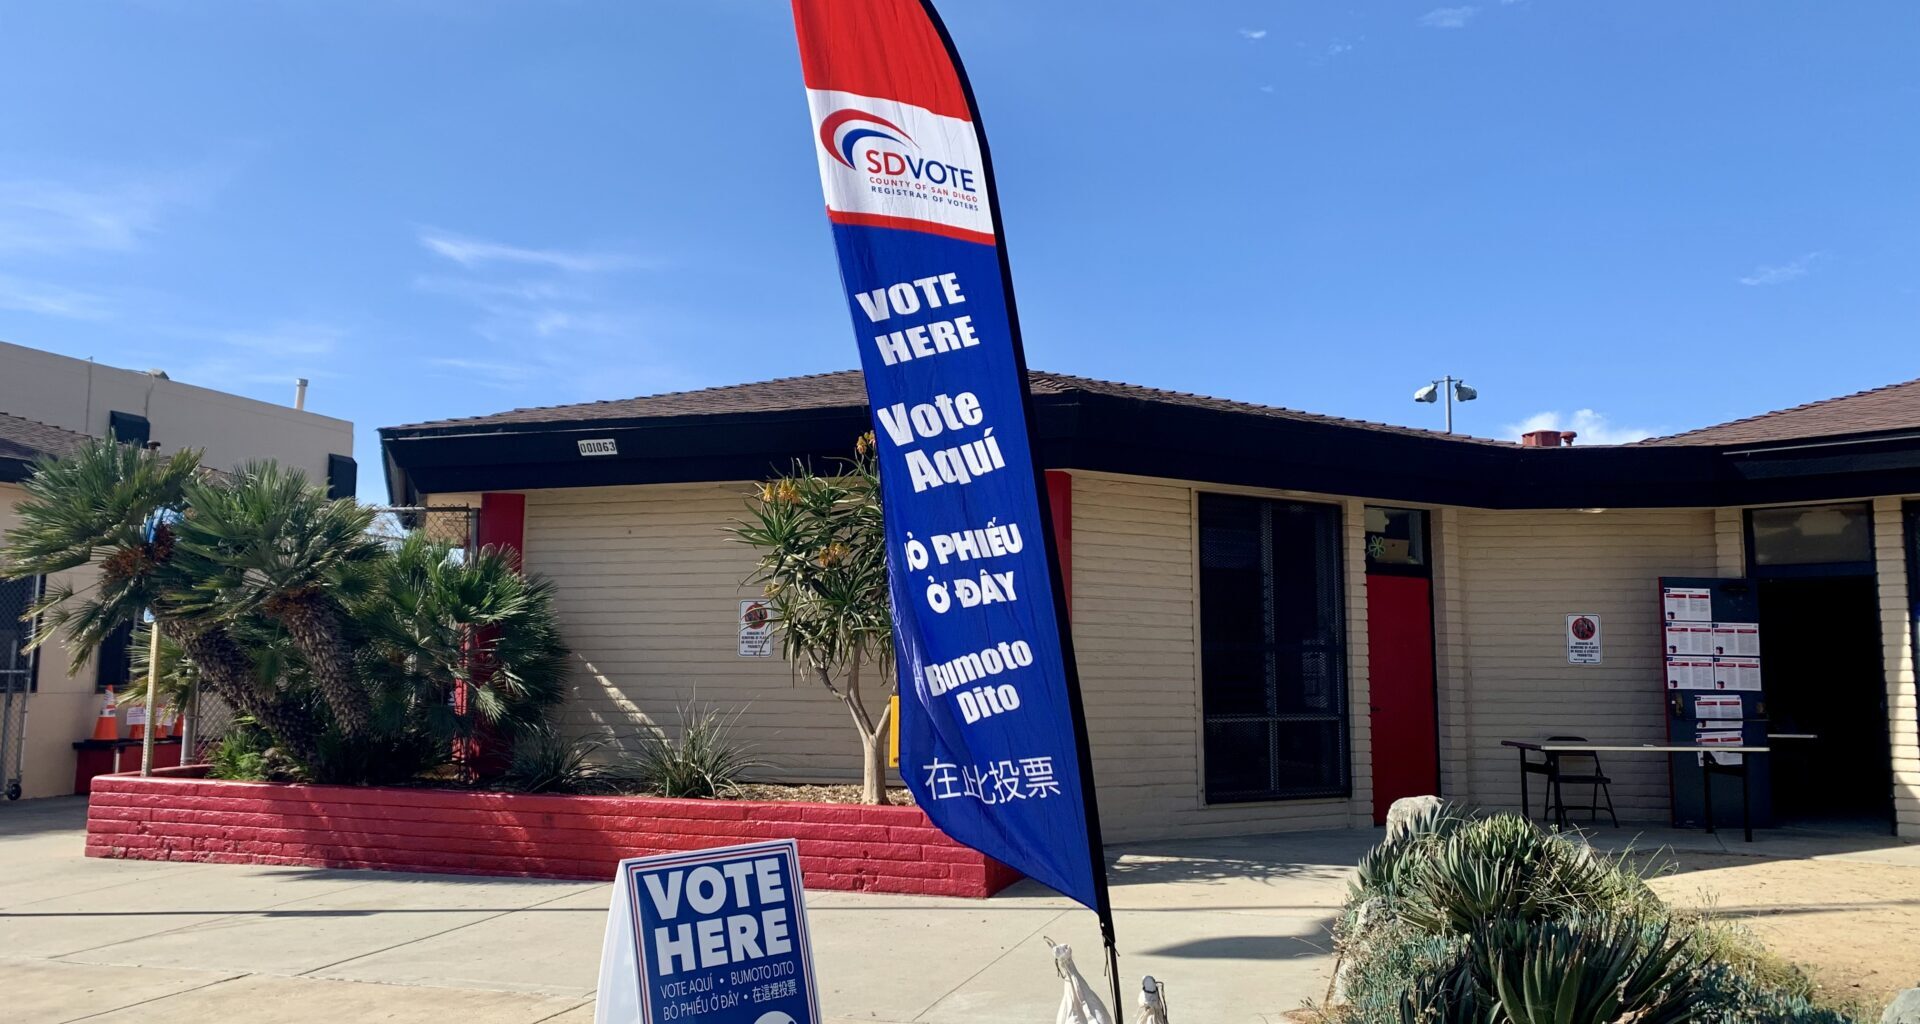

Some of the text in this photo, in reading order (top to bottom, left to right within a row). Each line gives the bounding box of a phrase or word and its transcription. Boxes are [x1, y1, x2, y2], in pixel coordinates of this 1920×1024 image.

[866, 149, 976, 192] SDVOTE
[869, 176, 911, 188] COUNTY
[930, 187, 949, 196] SAN
[952, 191, 978, 203] DIEGO
[871, 185, 979, 211] REGISTRAR OF VOTERS
[855, 272, 966, 323] VOTE
[874, 315, 981, 367] HERE
[877, 391, 984, 447] Vote
[904, 426, 1006, 494] Aquí
[903, 516, 1024, 572] Ỏ PHIẾU
[926, 568, 1018, 614] Ở ĐÂY
[924, 640, 1034, 697] Bumoto
[956, 684, 1021, 725] Dito
[923, 756, 1062, 805] 在此投票
[643, 857, 786, 921] VOTE
[654, 908, 792, 977] HERE
[660, 960, 795, 999] VOTE AQUÍ BUMOTO DITO
[663, 1001, 679, 1021] BỎ
[680, 995, 709, 1017] PHIẾU
[720, 990, 740, 1009] ĐÂY
